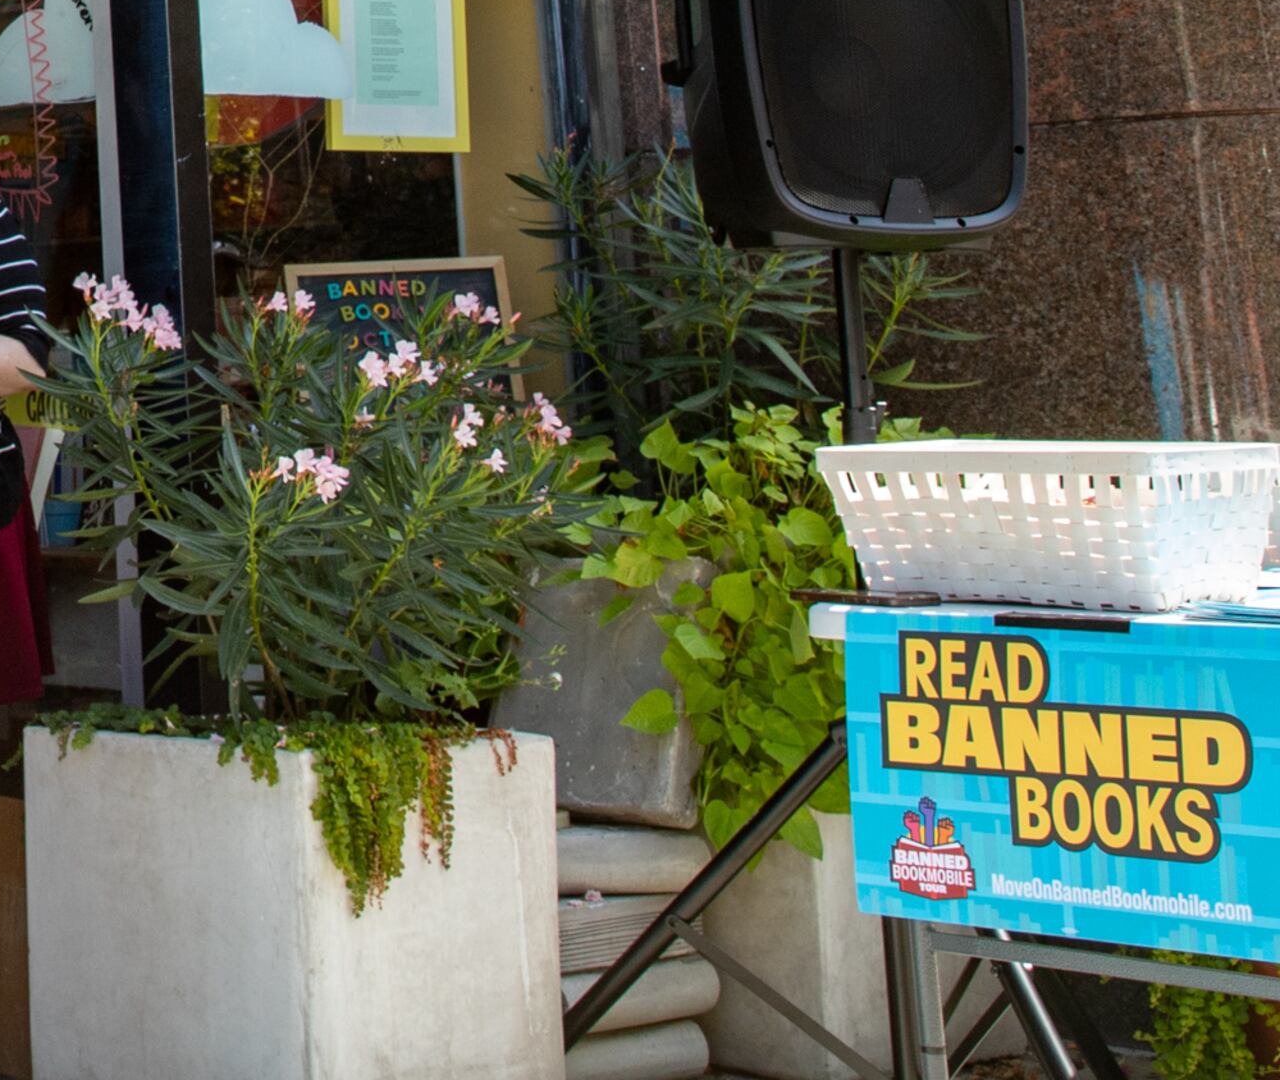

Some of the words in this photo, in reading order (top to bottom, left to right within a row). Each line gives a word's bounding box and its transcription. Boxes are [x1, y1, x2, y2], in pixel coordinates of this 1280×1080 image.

[327, 279, 425, 300] BANNED
[341, 303, 424, 321] BOOK
[905, 639, 1044, 703] READ
[887, 701, 1246, 786] BANNED
[1016, 777, 1214, 857] BOOKS
[894, 850, 968, 870] BANNED
[892, 867, 973, 888] BOOKMOBILE
[919, 884, 947, 894] TOUR
[992, 874, 1252, 922] MoveOnBannedBookmobile.com
